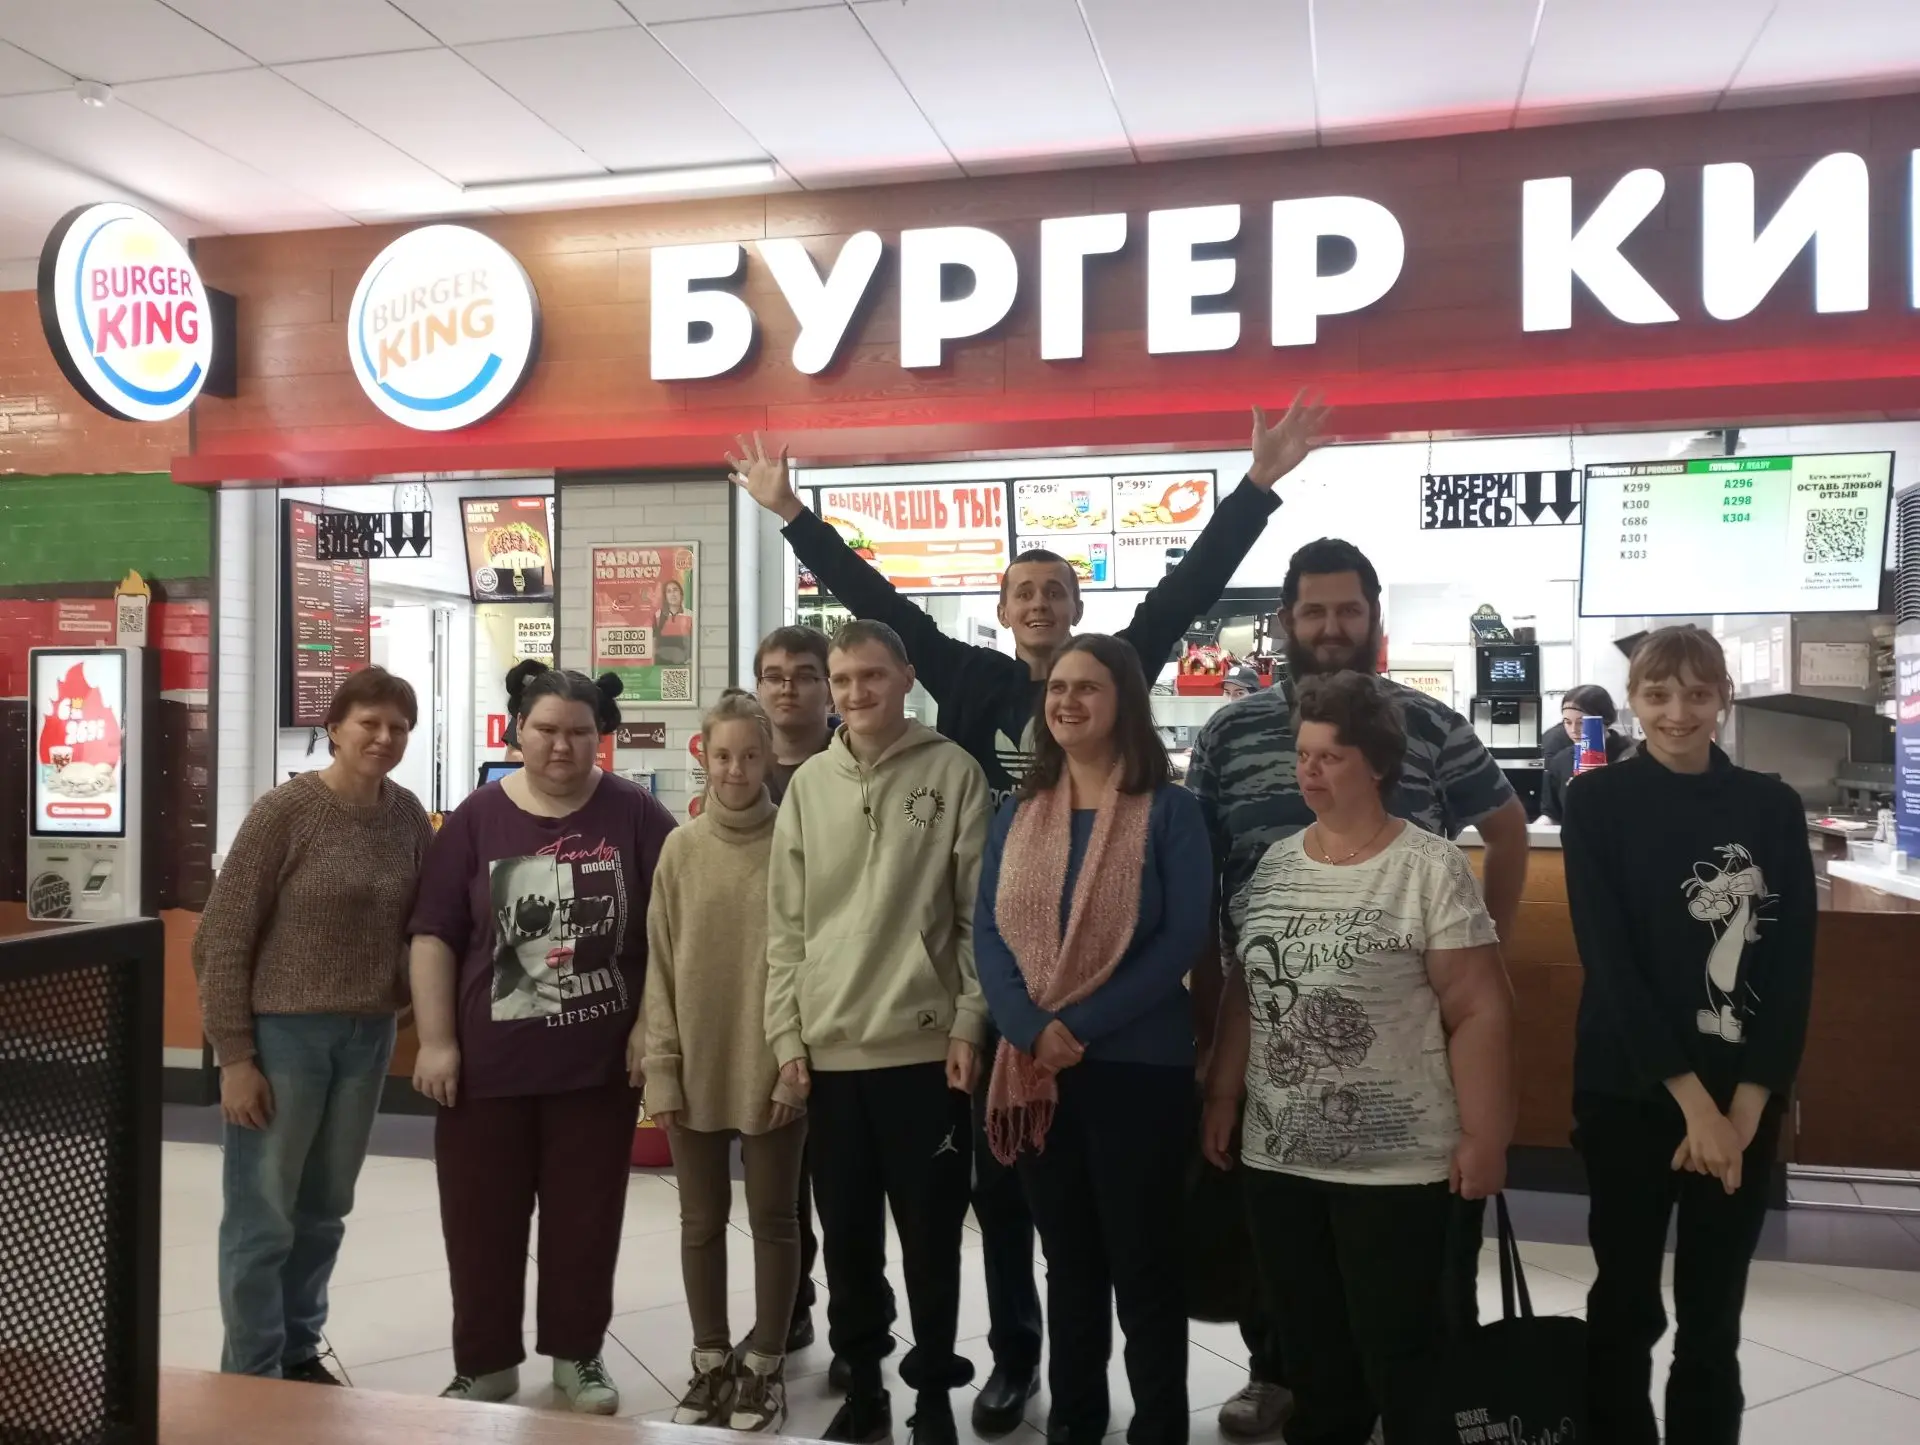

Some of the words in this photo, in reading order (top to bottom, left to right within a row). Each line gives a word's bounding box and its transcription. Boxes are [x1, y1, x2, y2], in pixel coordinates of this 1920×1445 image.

[650, 195, 1406, 381] БУРГЕР
[1522, 150, 1920, 332] КИ
[91, 265, 194, 301] BURGER
[373, 269, 490, 335] BURGER
[96, 300, 199, 354] KING
[379, 298, 495, 379] KING
[1019, 485, 1025, 494] 6
[1033, 485, 1053, 493] 269
[1117, 481, 1124, 490] 9
[1132, 481, 1146, 489] 99
[1425, 473, 1513, 499] ЗАБЕРИ
[1797, 483, 1840, 491] ОСТАВЬ
[1842, 480, 1882, 490] ЛЮБОЙ
[1820, 491, 1858, 499] ОТЗЫВ
[828, 490, 948, 530] ВЫБИРАЕШЬ
[953, 487, 1002, 528] ТЫ!
[1425, 498, 1513, 527] ЗДЕСЬ
[317, 514, 384, 533] ЗАКАЖИ
[317, 532, 384, 558] ЗДЕСЬ
[1021, 541, 1041, 549] 349
[1119, 536, 1187, 546] ЭНЕРГЕТИК
[596, 550, 661, 566] РАБОТА
[596, 567, 614, 579] ПО
[617, 566, 661, 579] ВКУСУ
[518, 622, 552, 630] РАБОТА
[536, 834, 618, 866] Trendy
[581, 860, 615, 874] model
[32, 881, 70, 901] BURGER
[34, 891, 71, 917] KING
[1282, 931, 1413, 978] Christmas
[1455, 1408, 1490, 1427] CREATE
